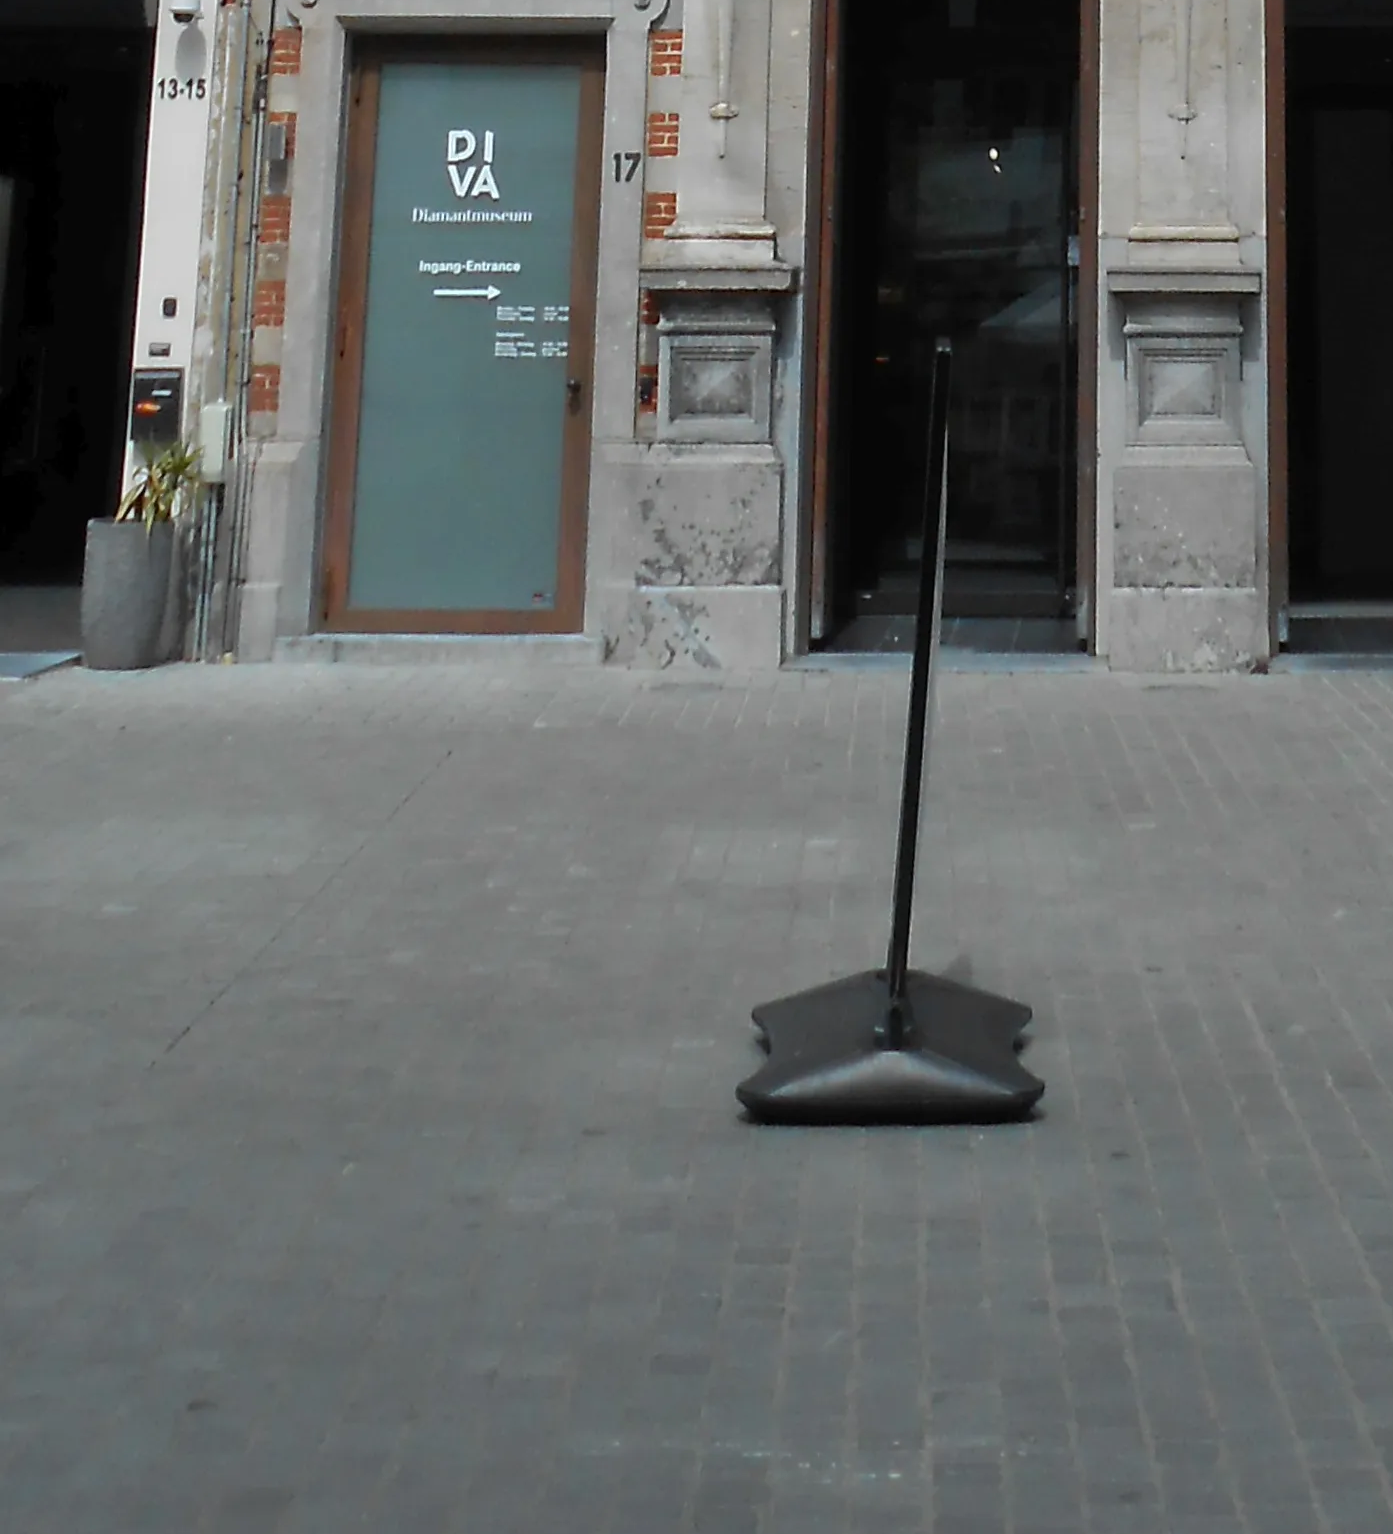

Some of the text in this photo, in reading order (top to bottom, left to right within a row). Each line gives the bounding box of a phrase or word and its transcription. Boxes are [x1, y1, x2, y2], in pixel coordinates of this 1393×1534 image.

[158, 77, 206, 100] 13-15
[613, 152, 642, 183] 17
[412, 207, 533, 223] Diamantmuseum
